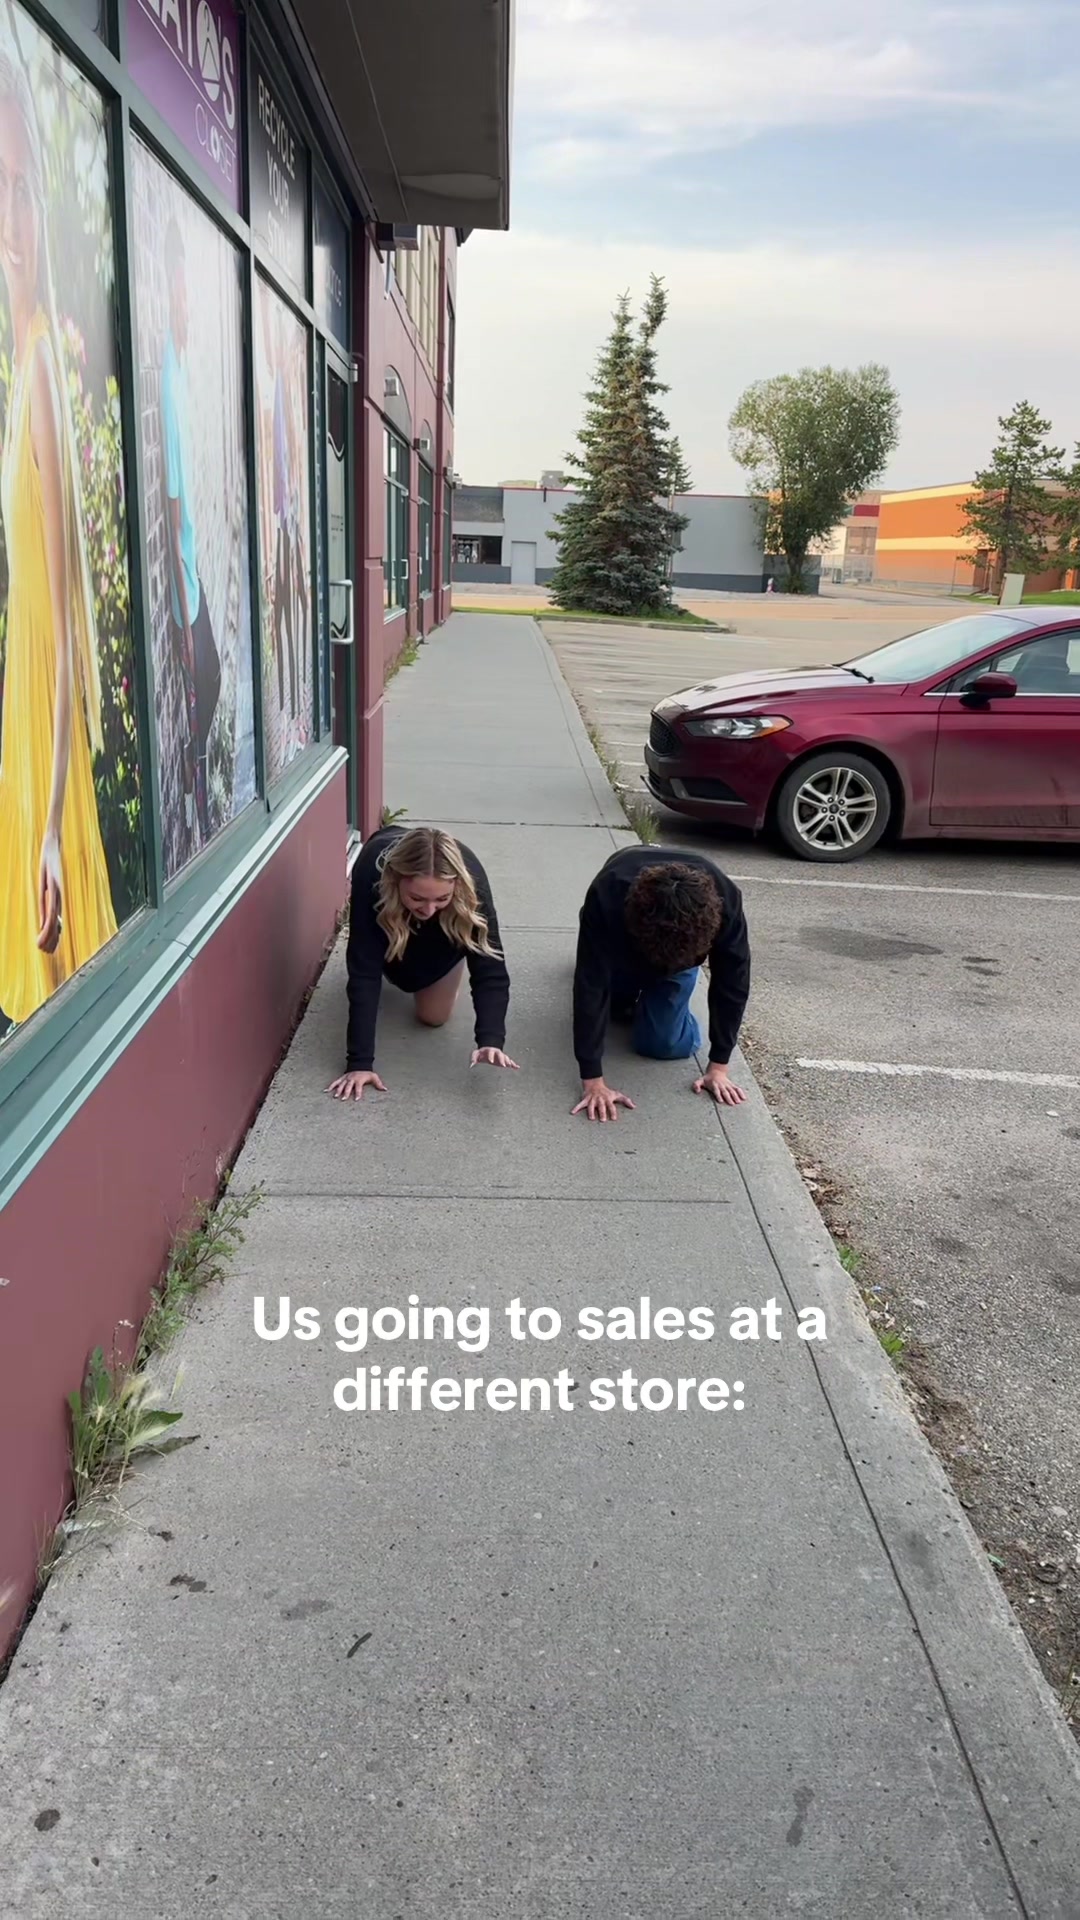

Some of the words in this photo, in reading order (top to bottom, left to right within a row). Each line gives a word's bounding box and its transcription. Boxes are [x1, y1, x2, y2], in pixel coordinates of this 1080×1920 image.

[194, 103, 237, 183] CLOSET
[257, 74, 296, 180] RECYCLE
[266, 150, 290, 220] YOUR
